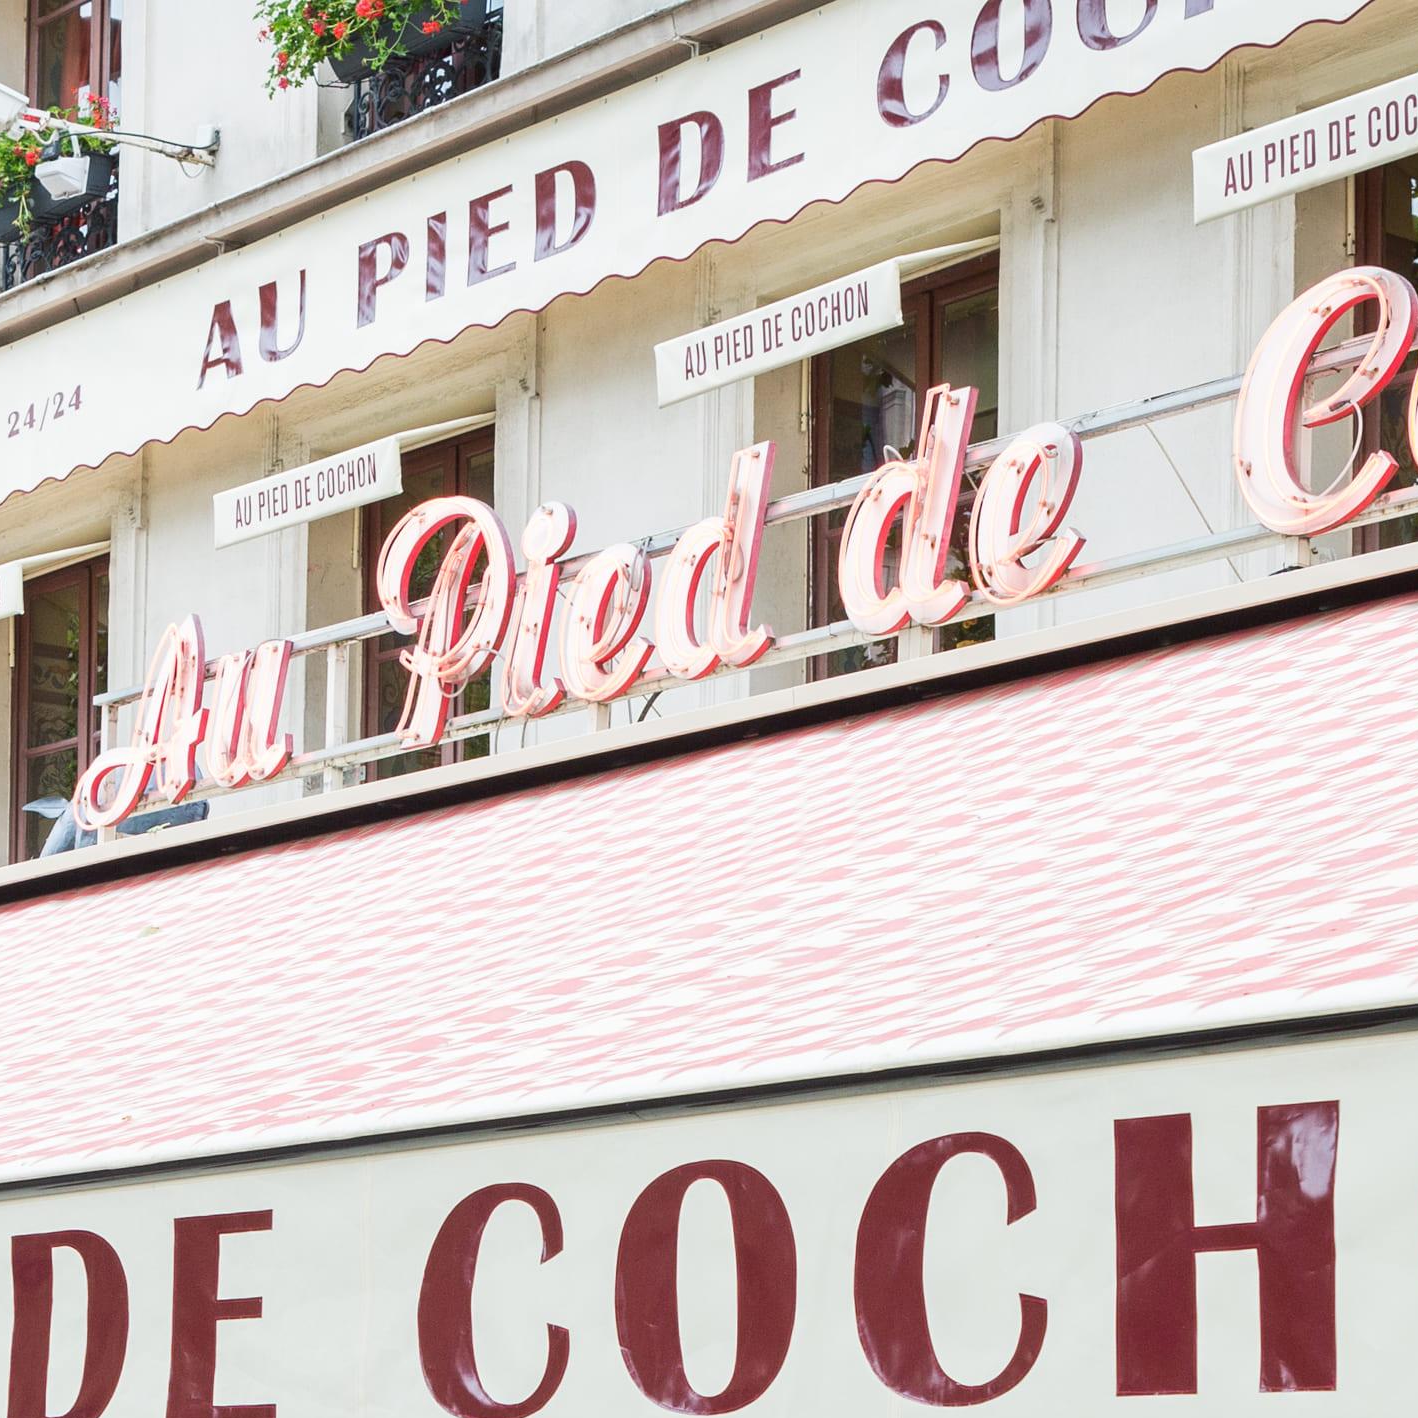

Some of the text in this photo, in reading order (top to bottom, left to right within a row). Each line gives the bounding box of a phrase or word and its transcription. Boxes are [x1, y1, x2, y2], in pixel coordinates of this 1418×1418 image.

[1224, 151, 1253, 197] AU
[1264, 128, 1316, 183] PIED
[1328, 114, 1356, 161] DE
[196, 269, 307, 390] AU
[357, 160, 597, 328] PIED
[657, 69, 805, 217] DE
[685, 281, 869, 381] AU PIED DE COCHON
[6, 384, 84, 439] 24/24
[235, 453, 377, 529] AU PIED DE COCHON
[72, 613, 296, 832] Au
[376, 440, 775, 750] Pied
[838, 383, 1088, 637] de
